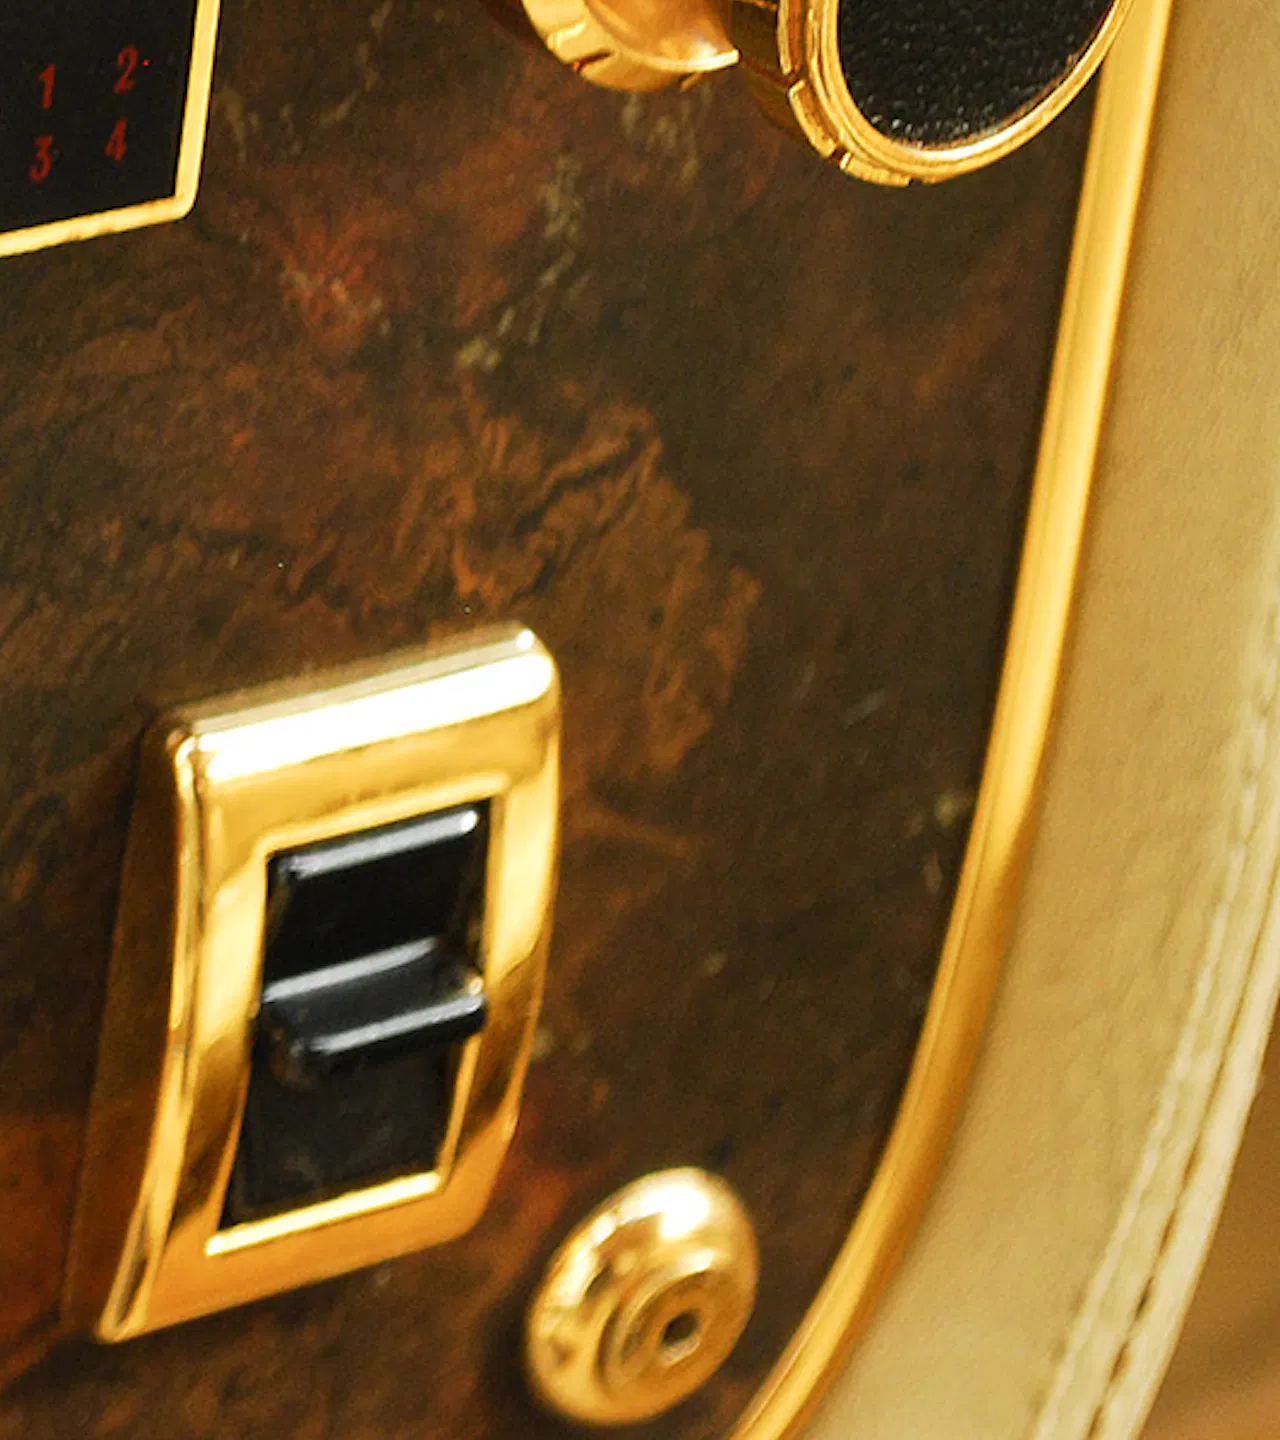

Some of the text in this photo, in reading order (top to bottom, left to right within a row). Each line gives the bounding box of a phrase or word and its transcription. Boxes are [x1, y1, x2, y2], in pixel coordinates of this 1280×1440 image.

[39, 44, 139, 109] 1 2
[31, 118, 128, 182] 3 4
